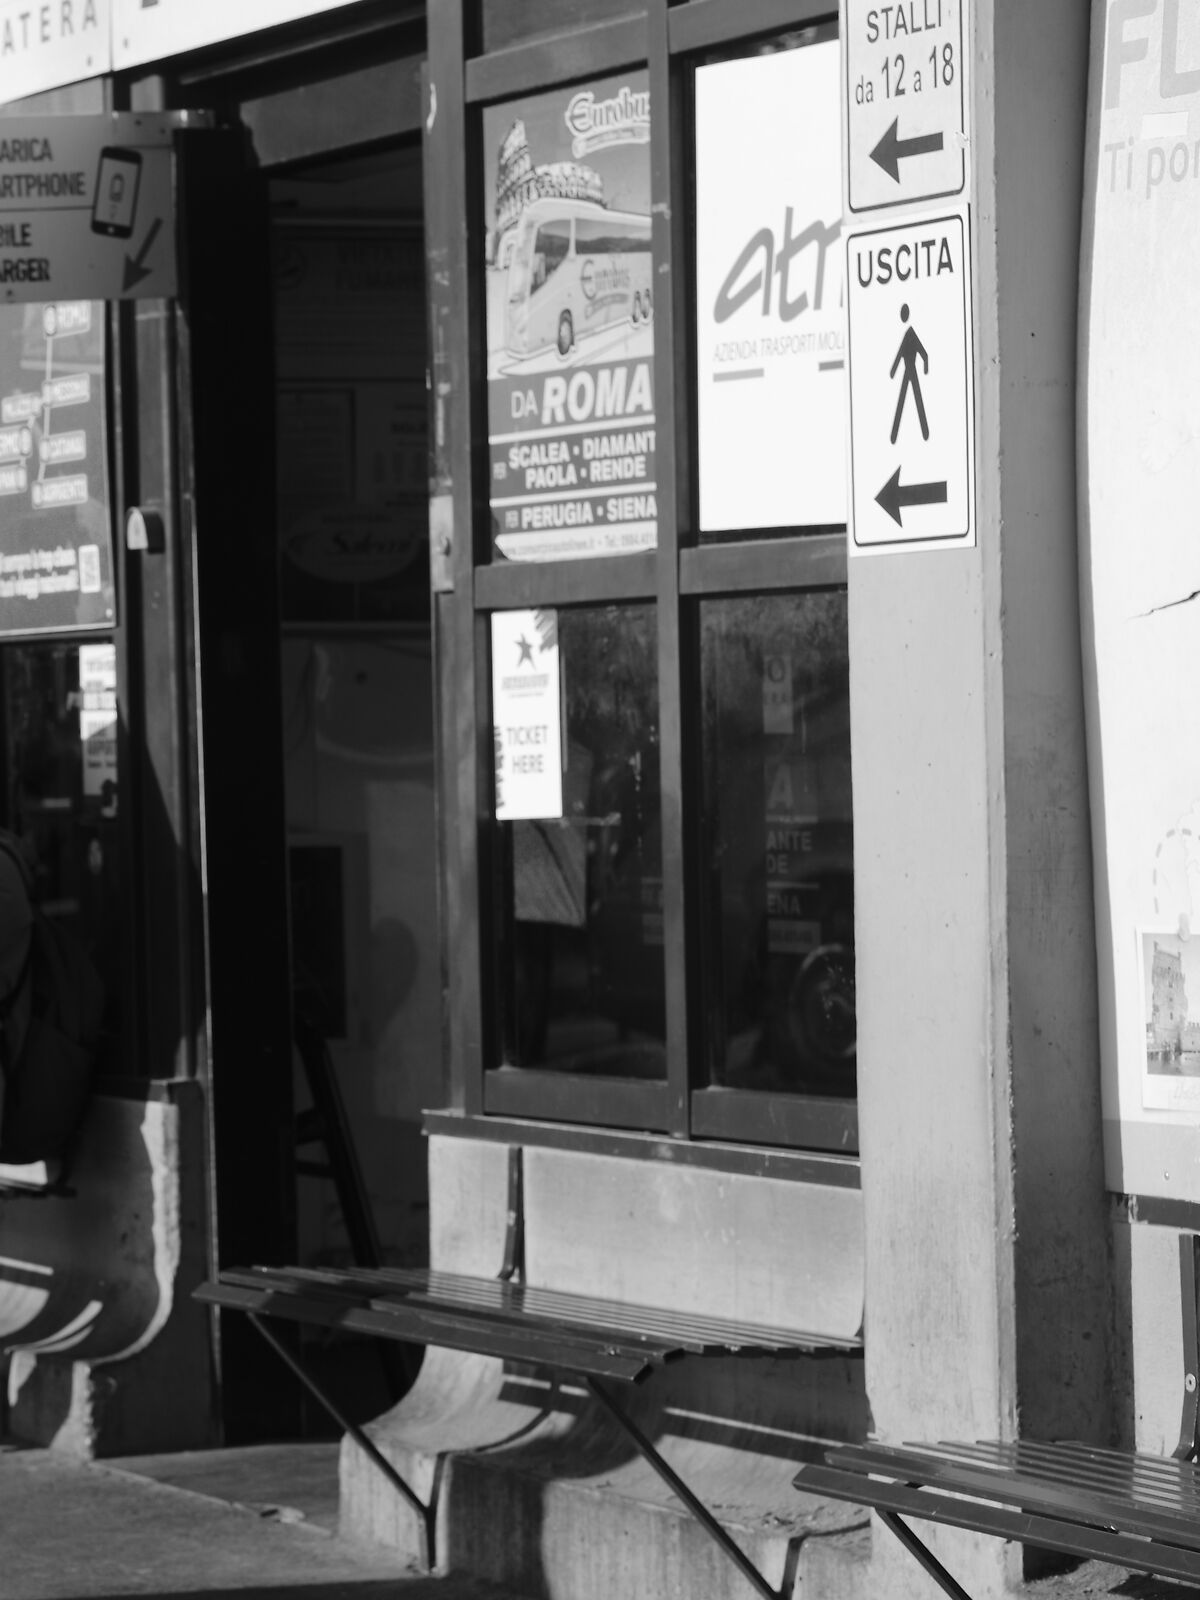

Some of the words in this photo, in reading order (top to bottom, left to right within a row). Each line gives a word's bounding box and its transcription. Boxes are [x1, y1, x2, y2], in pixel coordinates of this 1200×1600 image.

[866, 0, 942, 43] STALLI
[856, 75, 874, 105] da
[881, 54, 906, 99] 12
[913, 70, 922, 93] a
[929, 42, 954, 89] 18
[1104, 136, 1135, 192] Ti
[857, 237, 954, 288] USCITA
[510, 389, 538, 419] DA
[541, 362, 653, 425] ROMA
[508, 441, 570, 469] SCALEA
[525, 463, 578, 489] PAOLA
[590, 455, 646, 483] RENDE
[522, 501, 594, 529] PERUGIA
[606, 495, 657, 522] SIENA
[506, 724, 548, 746] TICKET
[512, 754, 544, 775] HERE
